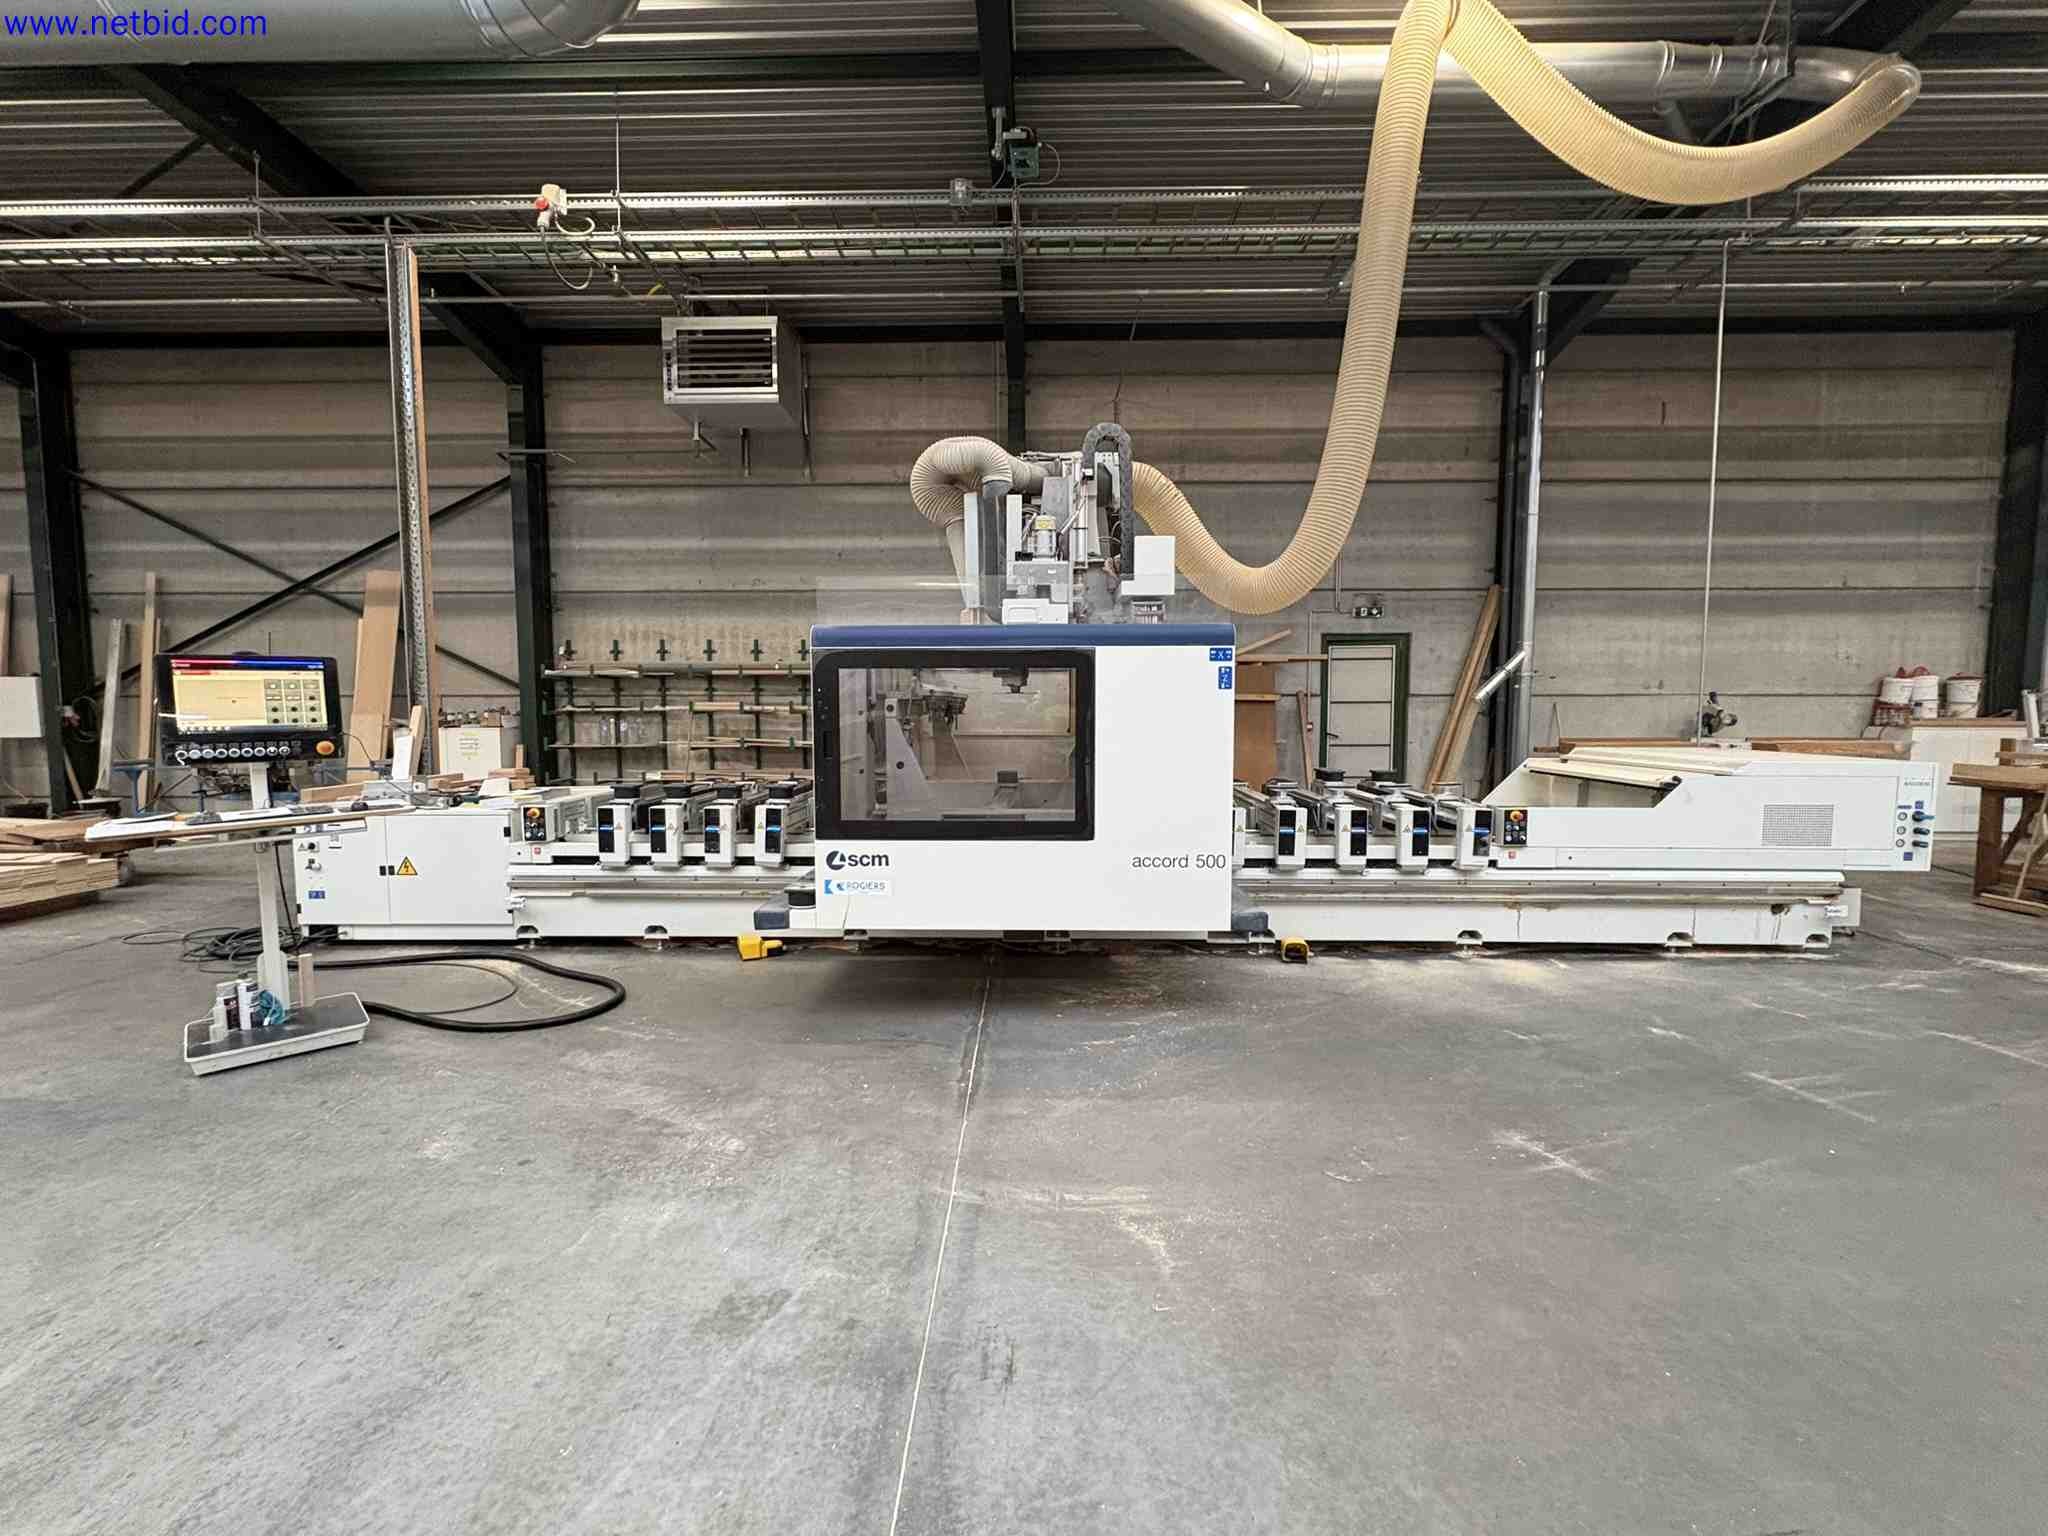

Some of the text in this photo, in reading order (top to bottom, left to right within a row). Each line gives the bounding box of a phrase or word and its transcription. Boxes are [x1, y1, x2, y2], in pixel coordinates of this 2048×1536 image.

[847, 854, 890, 867] scm
[1131, 854, 1226, 869] accord 500
